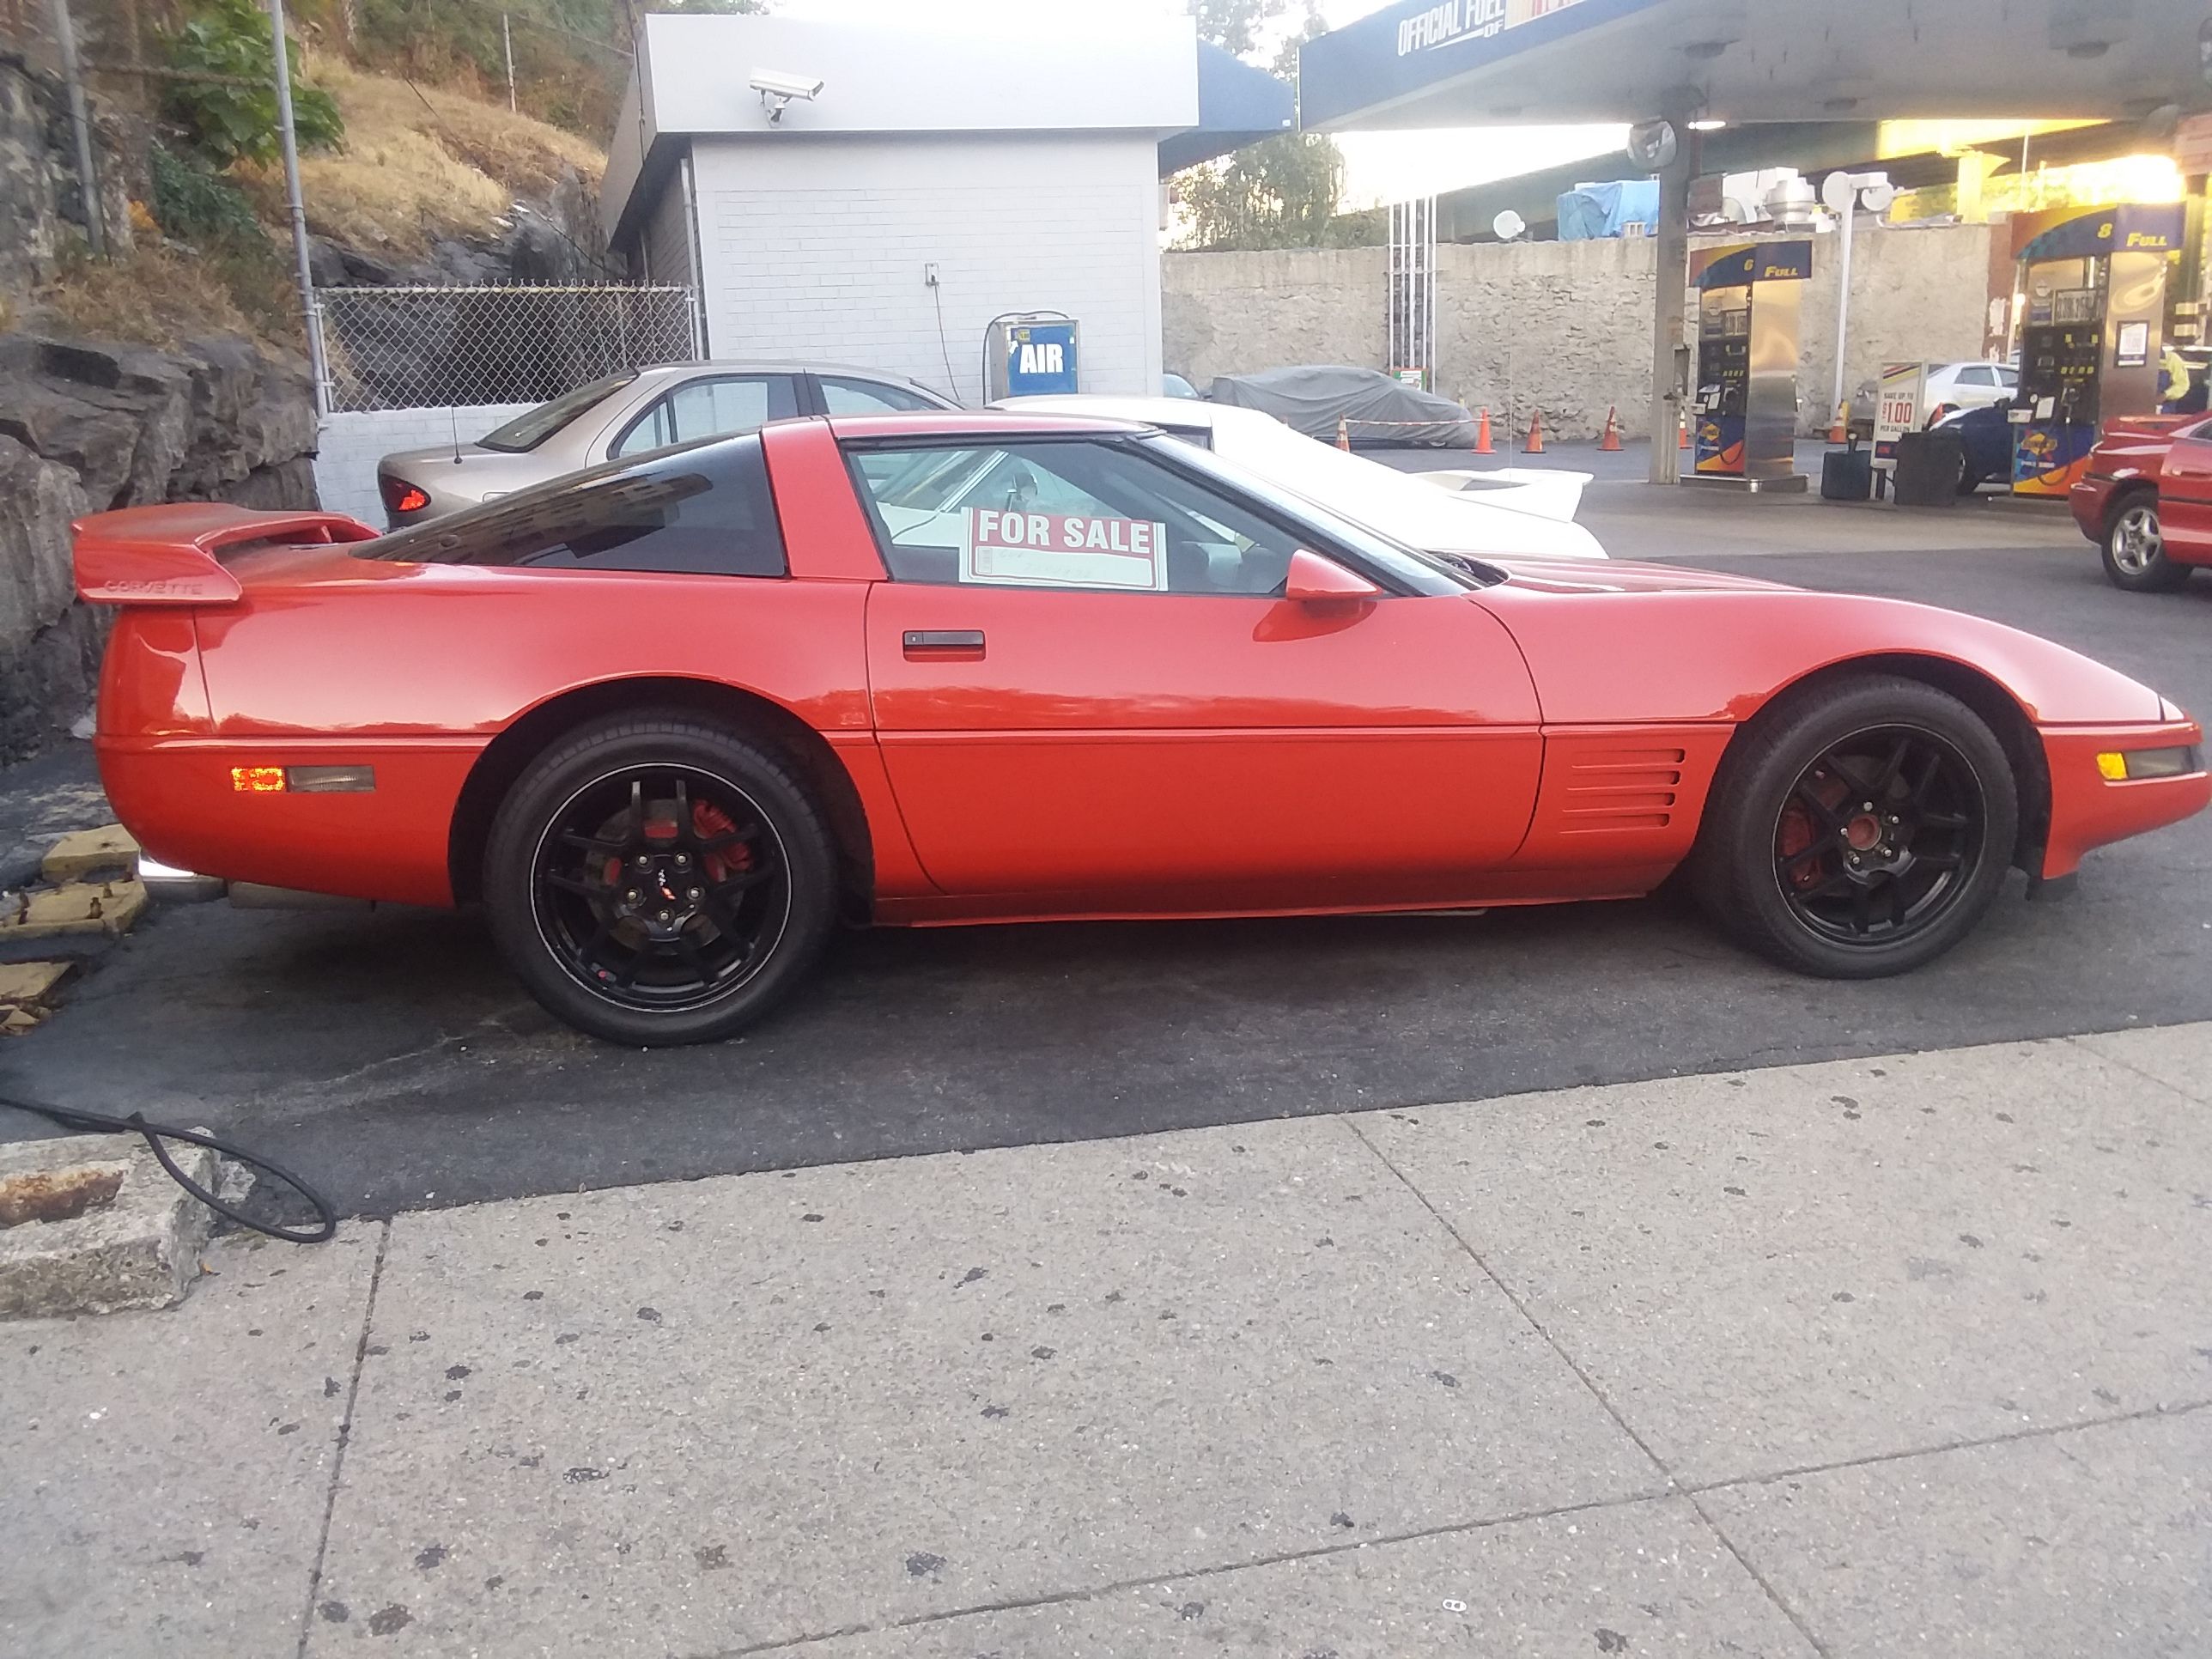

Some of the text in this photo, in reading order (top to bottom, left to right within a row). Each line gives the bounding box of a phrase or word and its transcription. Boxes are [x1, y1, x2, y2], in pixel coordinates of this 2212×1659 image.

[1398, 0, 1462, 57] OFFICIAL
[1484, 20, 1504, 38] OF
[2097, 223, 2112, 239] 8
[2126, 233, 2167, 246] FULL
[1743, 258, 1754, 271] 6
[1765, 265, 1798, 277] FULL
[1019, 343, 1064, 374] AIR
[979, 510, 1151, 554] FOR SALE
[104, 580, 204, 595] CORVETTE
